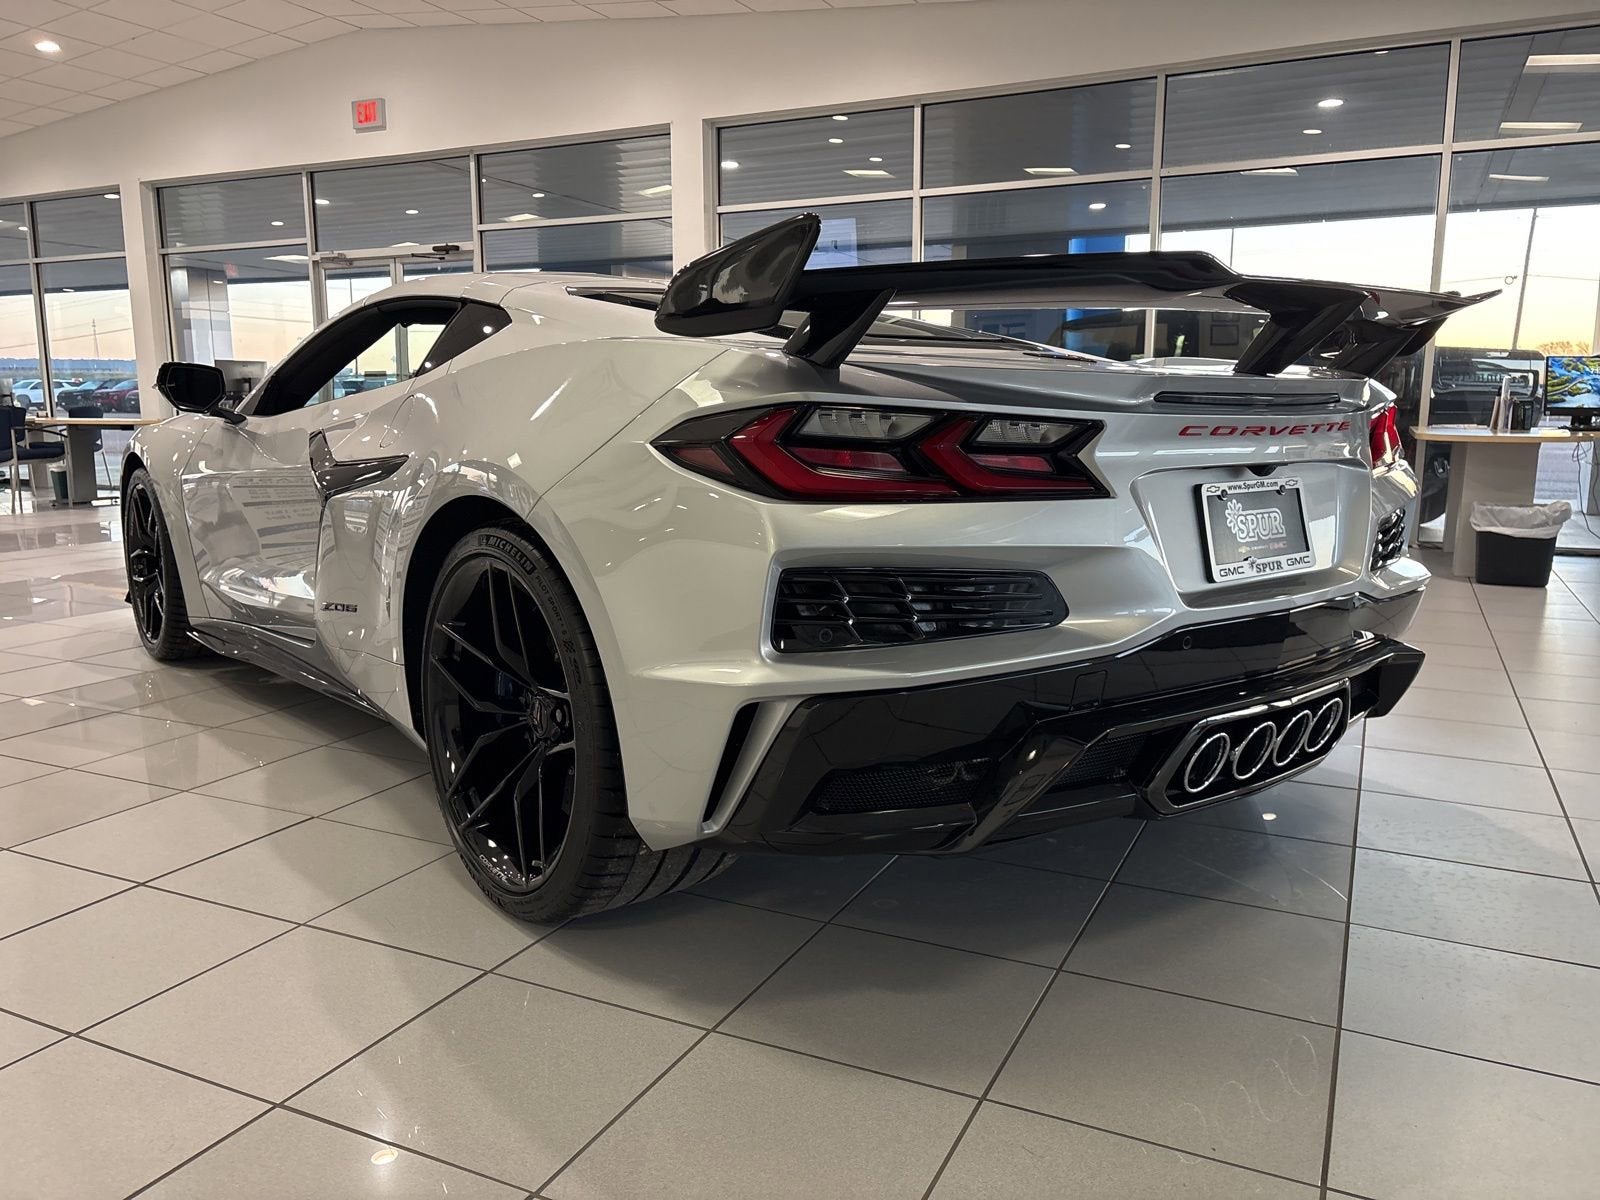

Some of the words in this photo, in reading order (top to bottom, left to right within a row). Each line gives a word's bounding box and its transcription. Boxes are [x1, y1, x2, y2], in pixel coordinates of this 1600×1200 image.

[357, 101, 377, 124] EXIT
[1178, 420, 1351, 437] CORVETTE
[1227, 480, 1279, 492] www.SpurGM.com
[1237, 510, 1285, 541] SPUR
[487, 534, 536, 574] MICHELIN
[1219, 565, 1245, 578] GMC
[1255, 560, 1284, 574] SPUR
[1286, 555, 1311, 567] GMC
[479, 854, 508, 883] CORVETTE
